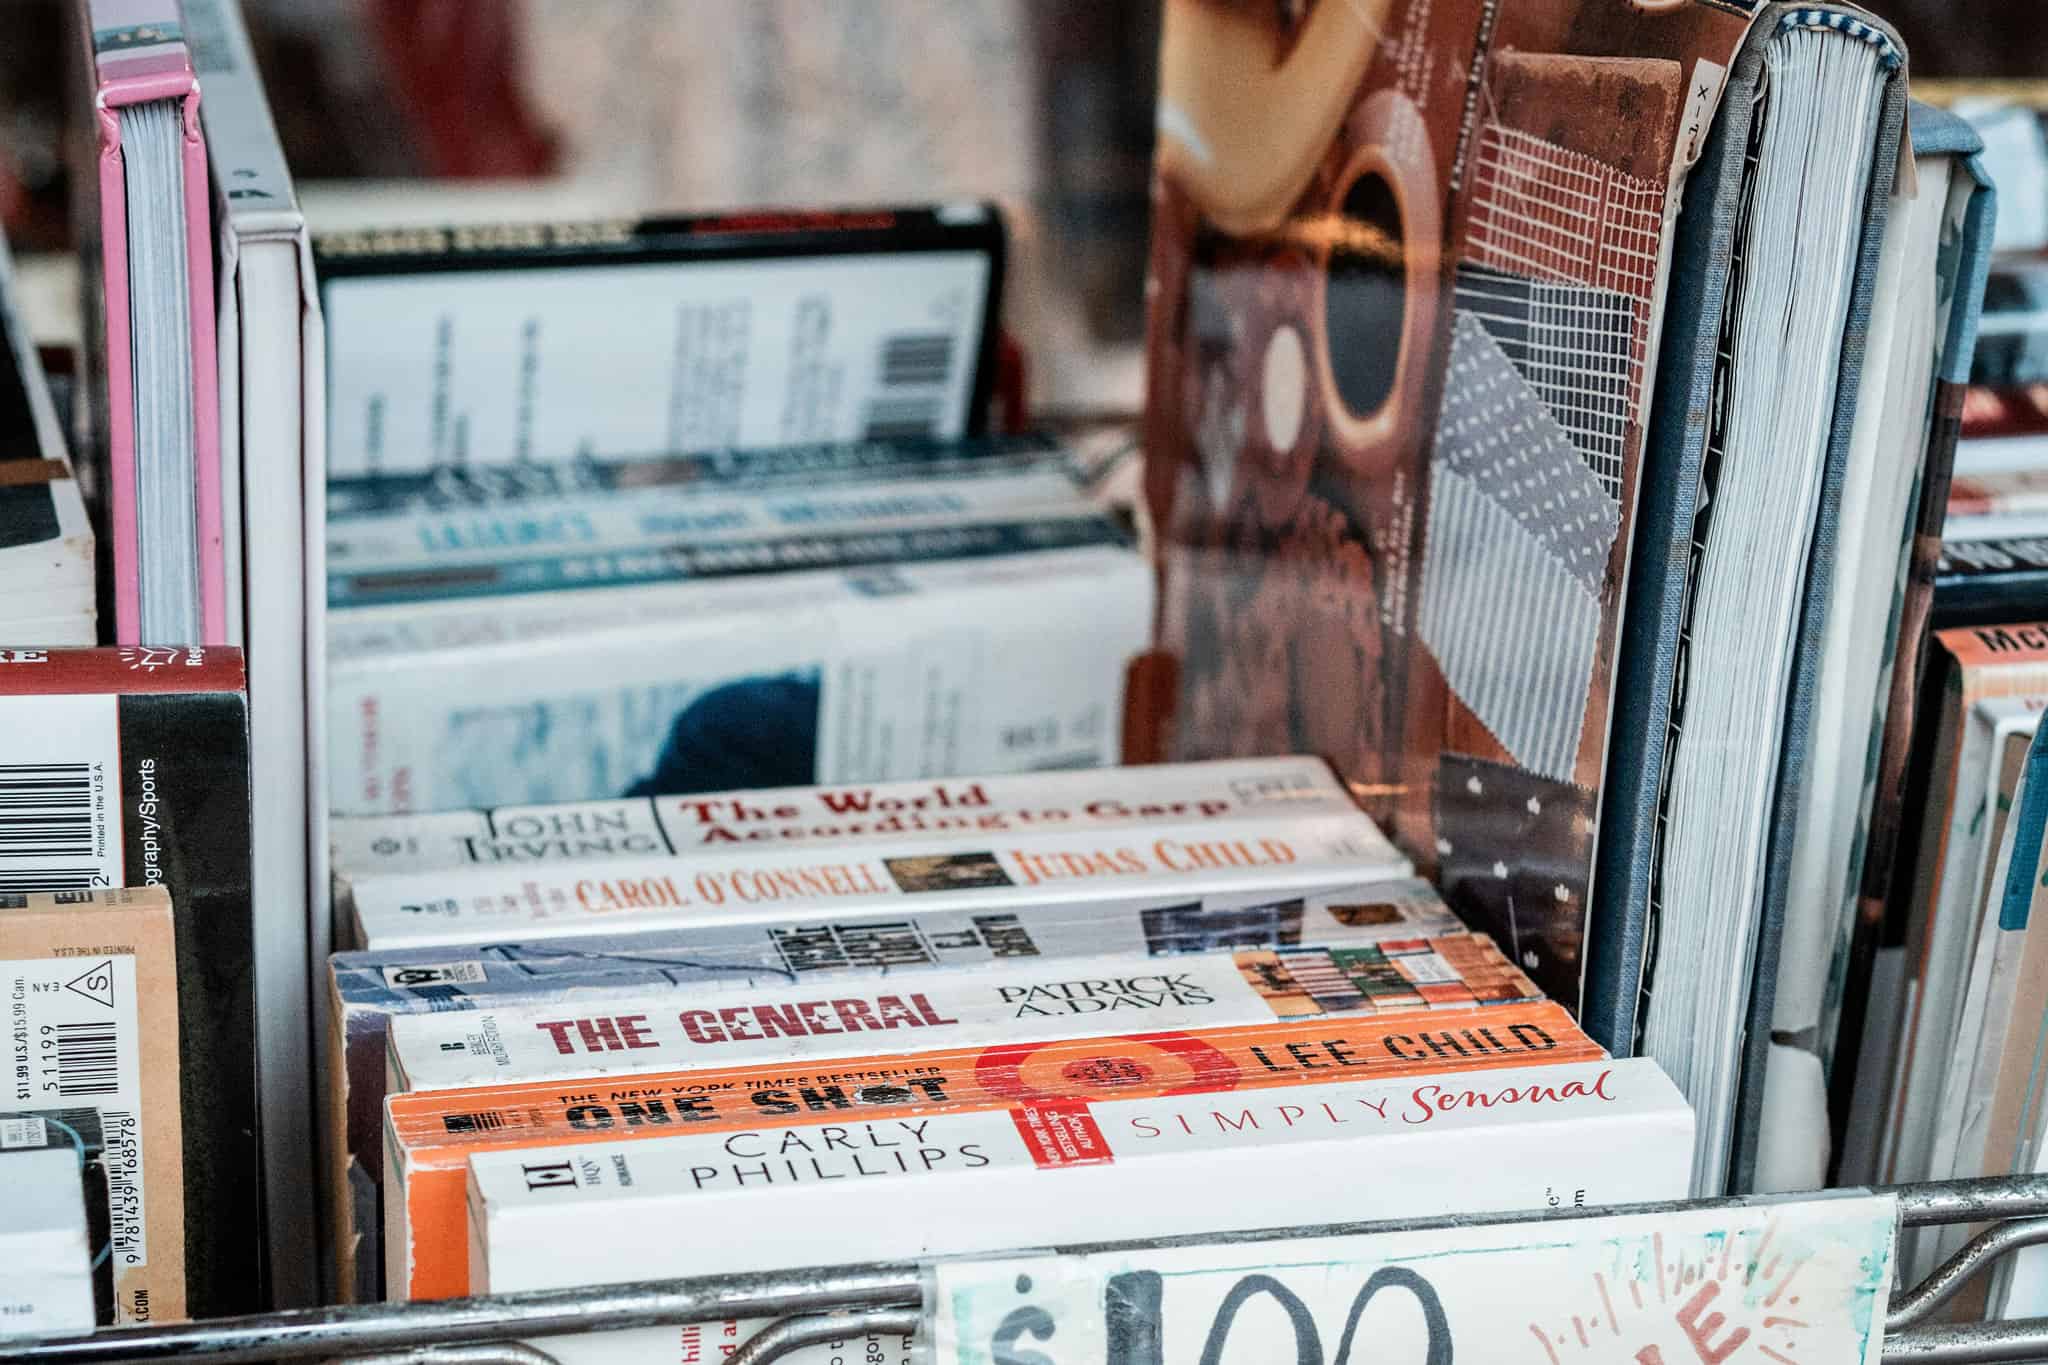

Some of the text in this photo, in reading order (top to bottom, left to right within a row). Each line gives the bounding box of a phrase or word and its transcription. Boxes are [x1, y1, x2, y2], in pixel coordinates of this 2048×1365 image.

[95, 795, 104, 811] the
[96, 813, 104, 822] in
[680, 783, 990, 825] The World
[703, 800, 1232, 843] According to Garp
[96, 824, 106, 858] Printed
[484, 807, 630, 839] JOHN
[91, 875, 110, 887] 2
[1010, 838, 1298, 886] JUDAS CHILD
[575, 876, 690, 913] CAROL
[695, 862, 889, 906] O'CONNELL
[996, 973, 1207, 1004] PATRICK
[536, 1014, 660, 1055] THE
[679, 993, 959, 1045] GENERAL
[1249, 1022, 1559, 1073] LEE CHILD
[15, 1065, 31, 1100] $11.99
[558, 1066, 942, 1105] THE NEW YORK TIMES BESTSELLER
[565, 1095, 722, 1131] ONE
[1023, 1107, 1044, 1128] TIMES
[1131, 1070, 1618, 1139] SIMPLY Sensual
[724, 1119, 929, 1158] CARLY
[1044, 1111, 1080, 1158] BESTSELLING
[1066, 1115, 1095, 1150] AUTHOR
[690, 1144, 990, 1190] PHILLIPS
